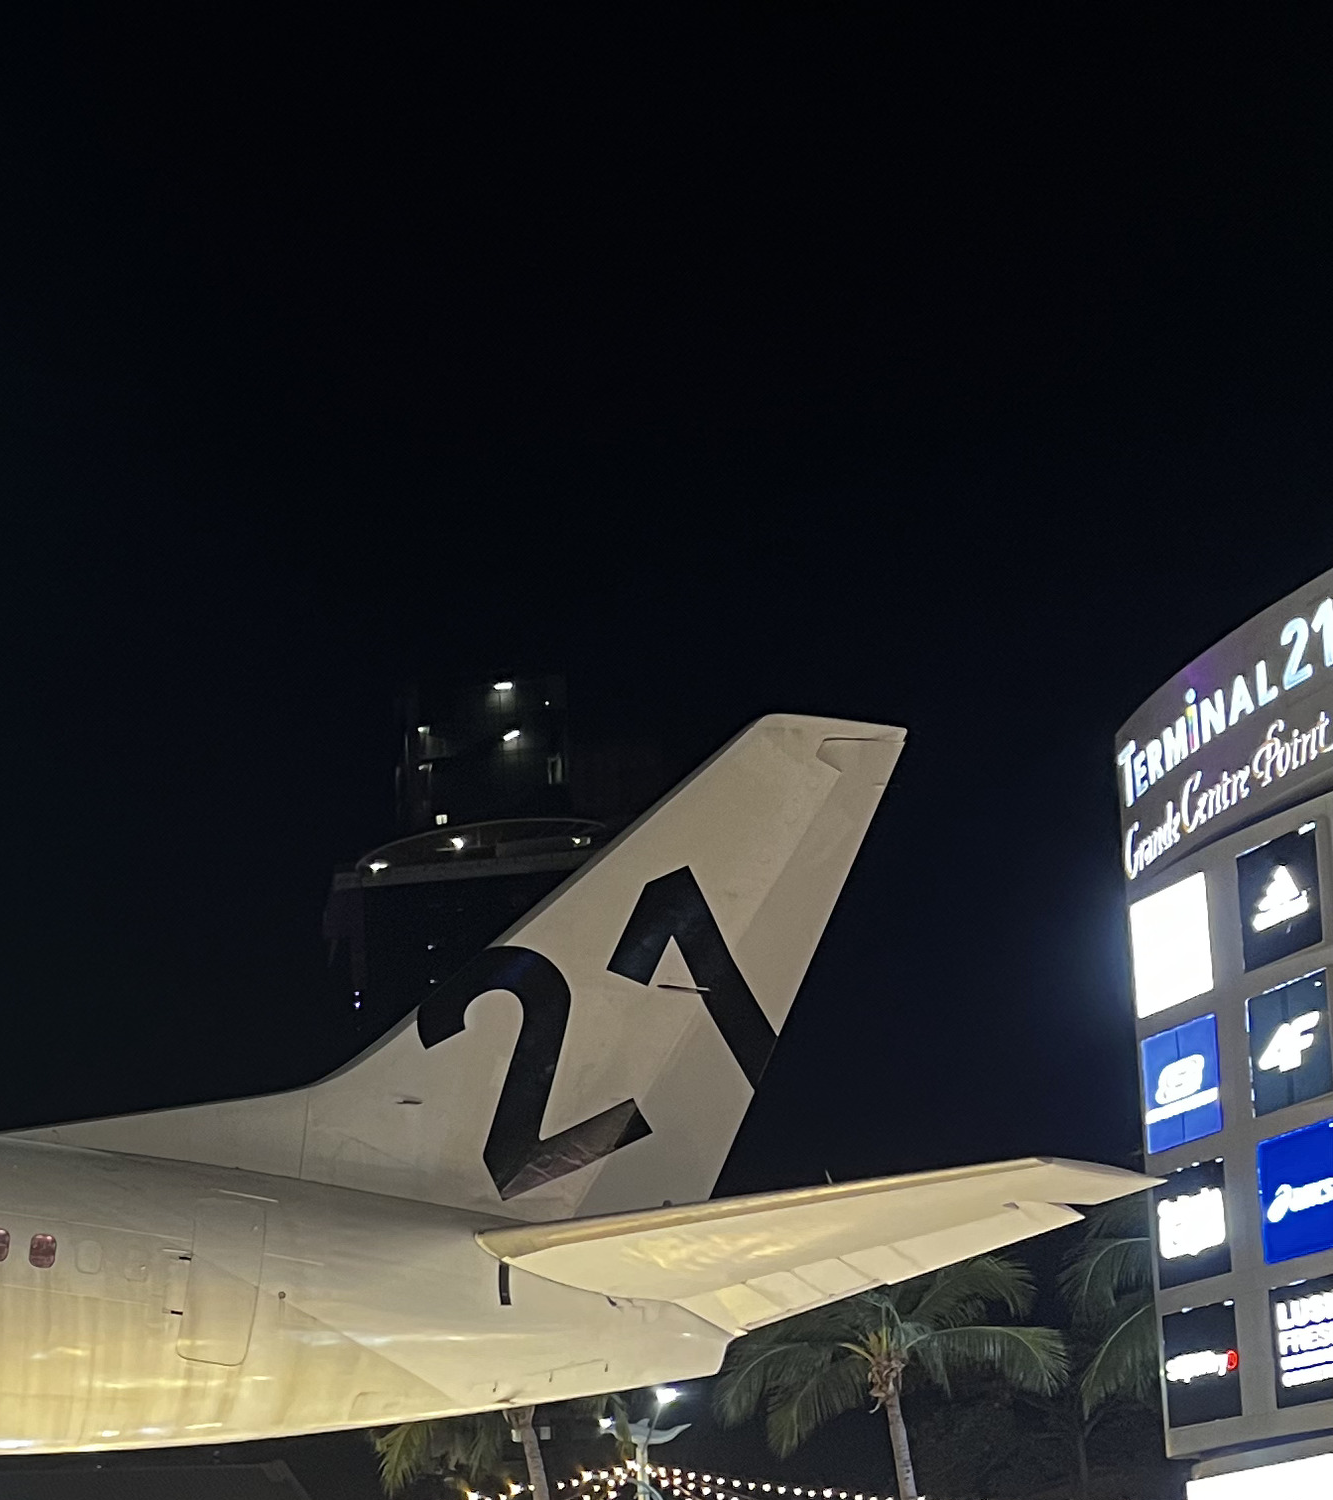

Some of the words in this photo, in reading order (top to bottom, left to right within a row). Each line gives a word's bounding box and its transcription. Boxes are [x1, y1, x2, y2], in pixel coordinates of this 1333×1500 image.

[1280, 597, 1333, 691] 21
[1124, 800, 1182, 880] Grande
[1181, 770, 1250, 834] Centre
[1252, 718, 1333, 788] Point
[1258, 1010, 1321, 1073] 4F
